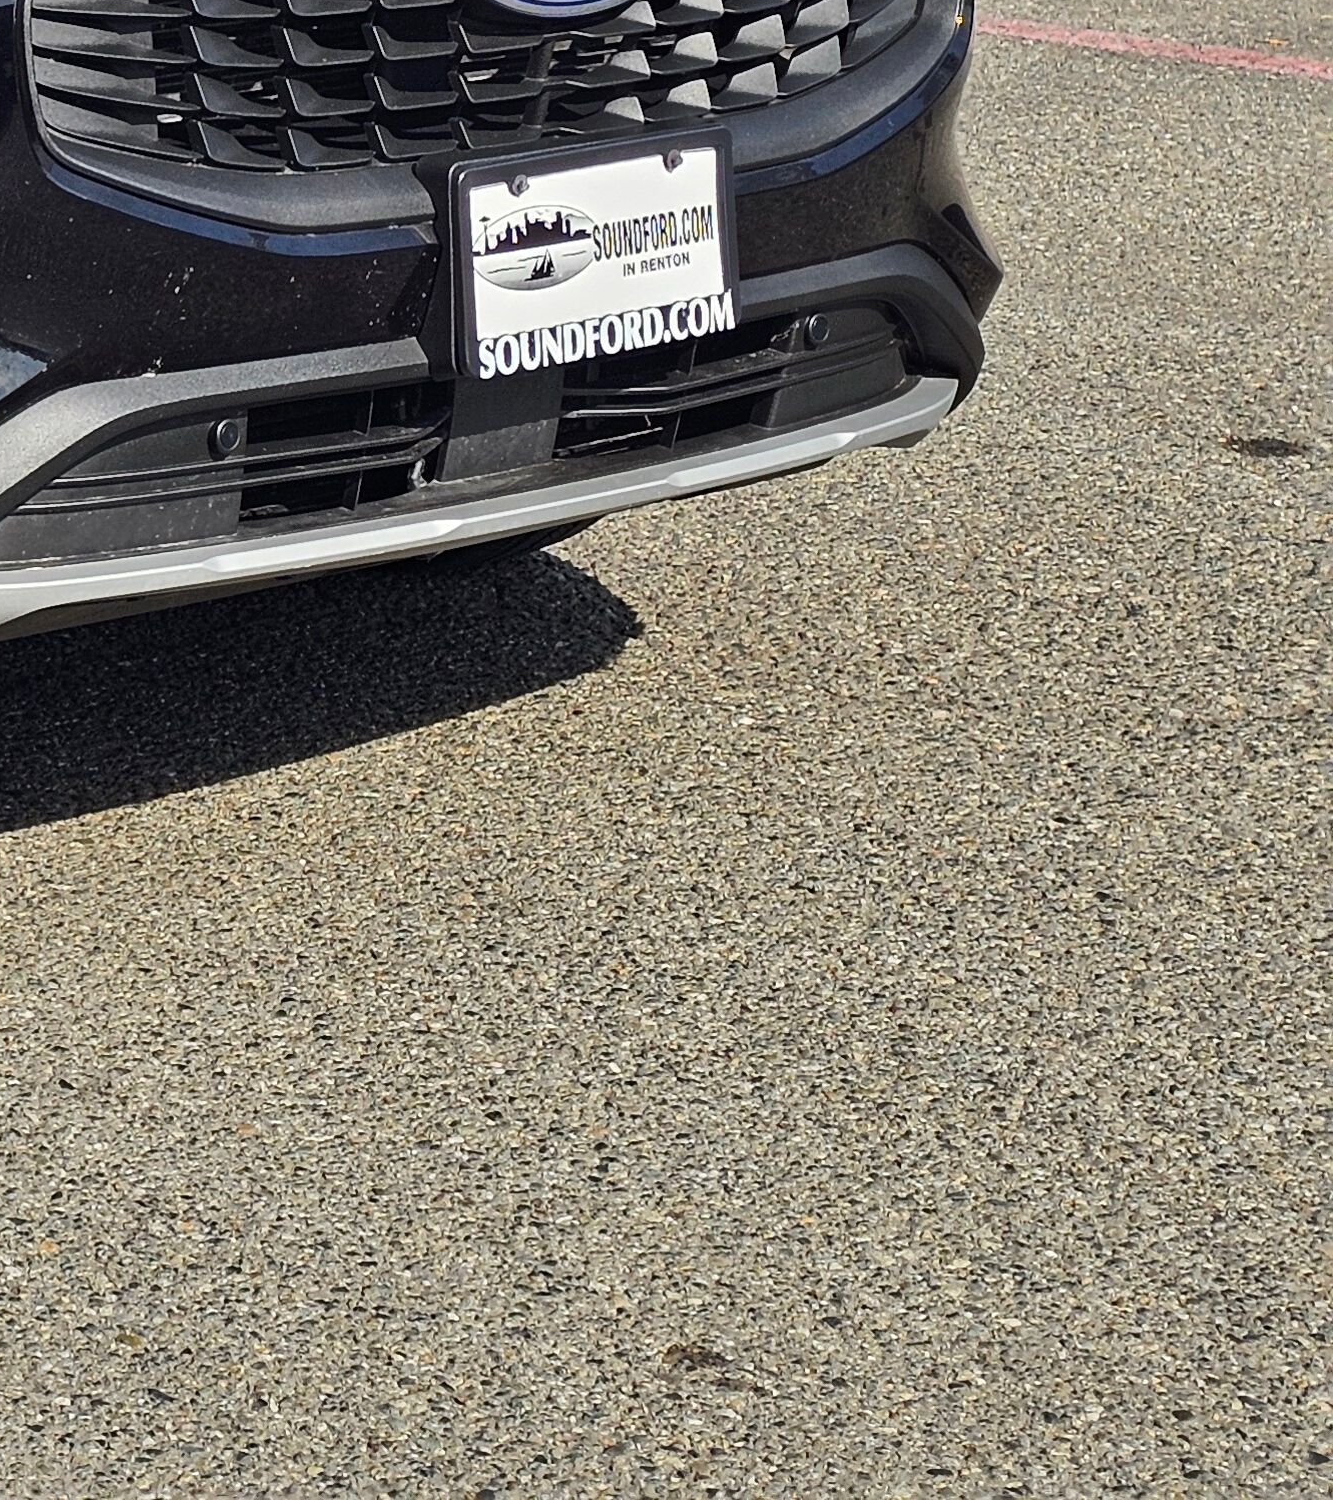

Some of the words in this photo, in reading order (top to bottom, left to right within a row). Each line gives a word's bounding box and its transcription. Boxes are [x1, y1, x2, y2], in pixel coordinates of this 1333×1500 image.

[592, 204, 714, 262] SOUNDFORD.COM
[623, 263, 636, 277] IN
[640, 251, 690, 274] RENTON
[479, 288, 736, 380] SOUNDFORD.COM
